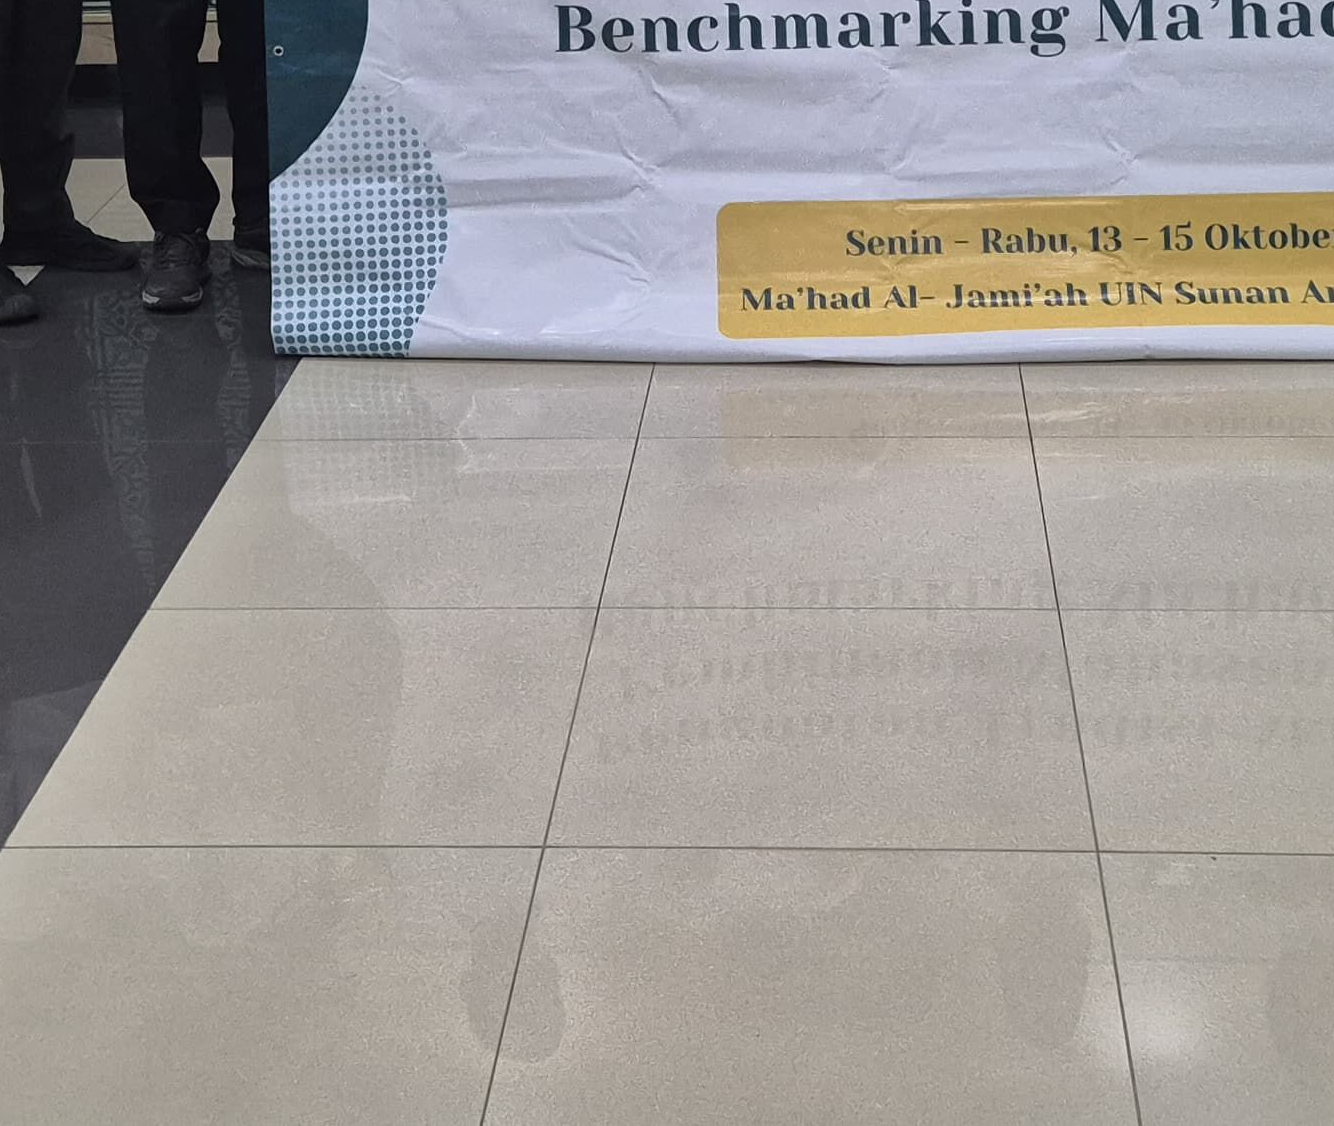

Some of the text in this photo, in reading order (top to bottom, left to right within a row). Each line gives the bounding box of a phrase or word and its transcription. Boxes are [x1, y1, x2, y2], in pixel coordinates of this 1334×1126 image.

[846, 228, 943, 257] Senin
[981, 226, 1078, 258] Rabu,
[1088, 225, 1123, 253] 13
[1159, 220, 1193, 252] 15
[740, 285, 871, 311] Ma'had
[884, 284, 936, 309] Al-
[945, 282, 1089, 310] Jami'ah
[1100, 282, 1164, 306] UIN
[1175, 278, 1290, 305] Sunan
